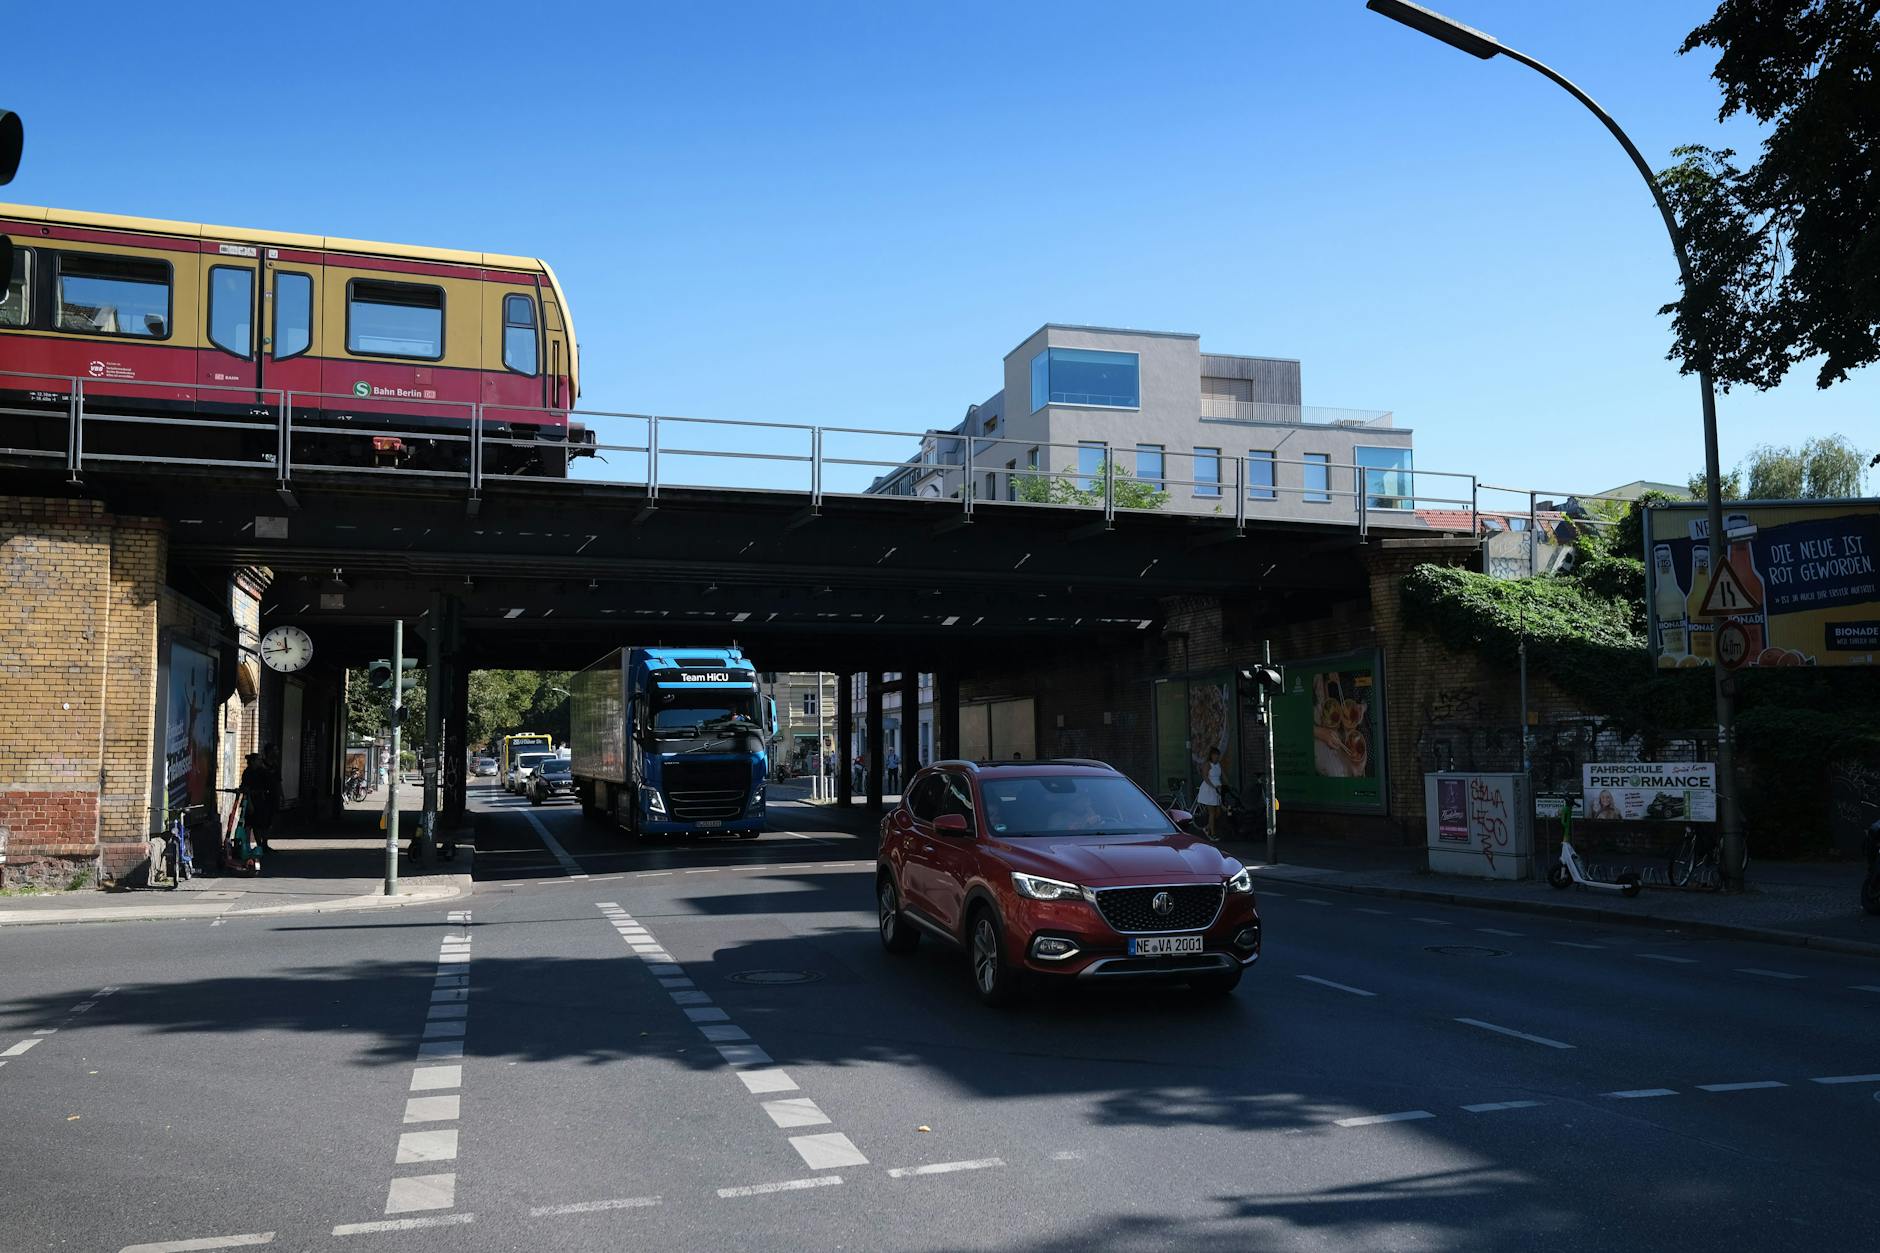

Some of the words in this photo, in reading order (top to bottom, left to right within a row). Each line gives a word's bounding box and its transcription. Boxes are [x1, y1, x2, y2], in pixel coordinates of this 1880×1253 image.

[356, 383, 368, 397] S
[373, 386, 395, 396] Bahn
[396, 388, 422, 397] Berlin
[1771, 544, 1795, 564] DIE
[1800, 538, 1837, 560] NEUE
[1842, 535, 1863, 556] IST
[1768, 566, 1793, 585] ROT
[1800, 555, 1876, 581] GEWORDEN.
[1835, 627, 1880, 636] BIONADE
[681, 673, 705, 682] Team
[707, 673, 728, 682] HiCU
[1590, 765, 1663, 773] FAHRSCHULE
[1590, 776, 1710, 787] PERFORMANCE
[1136, 940, 1150, 952] NE
[1158, 939, 1172, 952] VA
[1175, 938, 1201, 951] 2001
